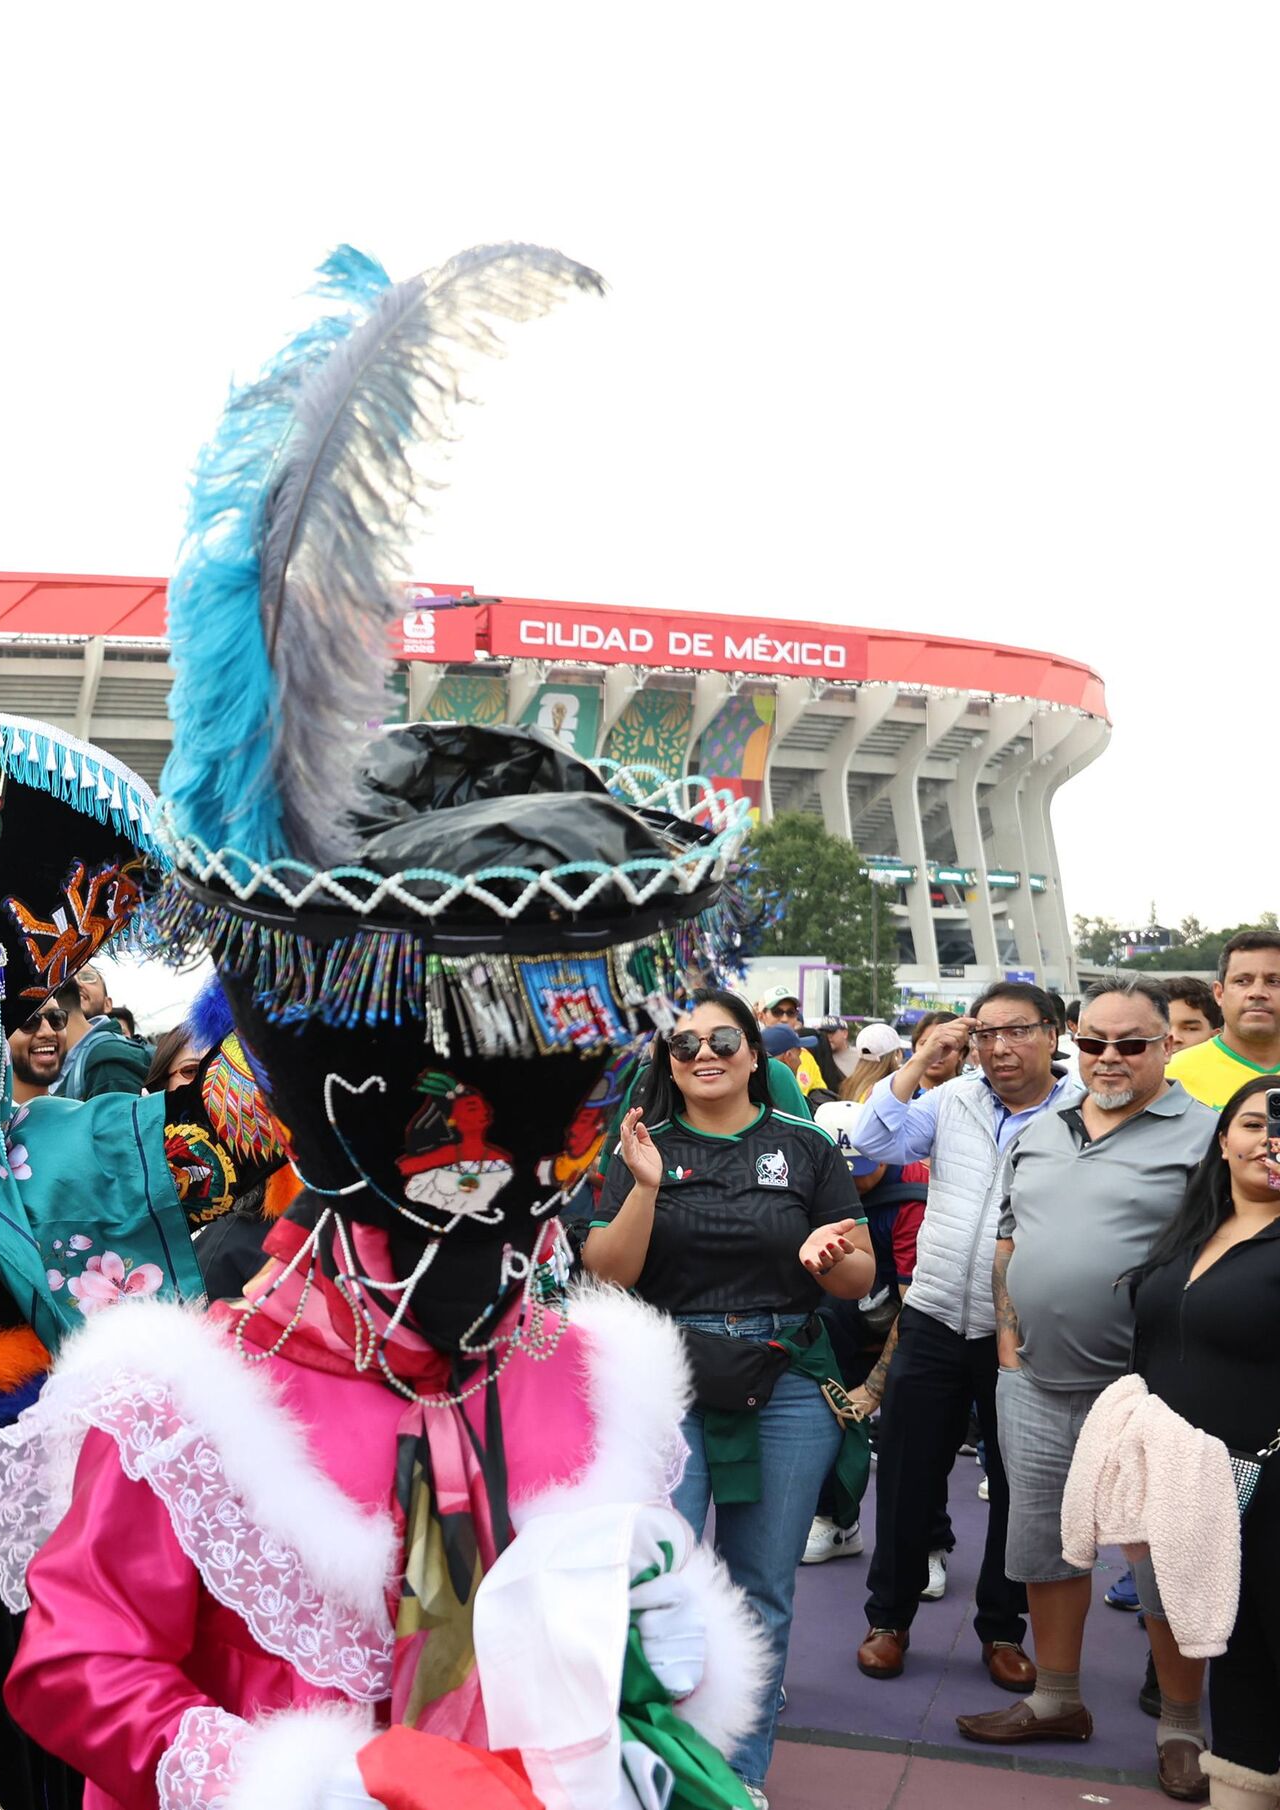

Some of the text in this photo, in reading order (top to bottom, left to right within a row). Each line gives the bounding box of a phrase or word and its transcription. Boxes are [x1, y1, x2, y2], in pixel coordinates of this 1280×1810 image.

[519, 620, 846, 668] CIUDAD DE MÉXICO
[837, 1128, 852, 1149] LA
